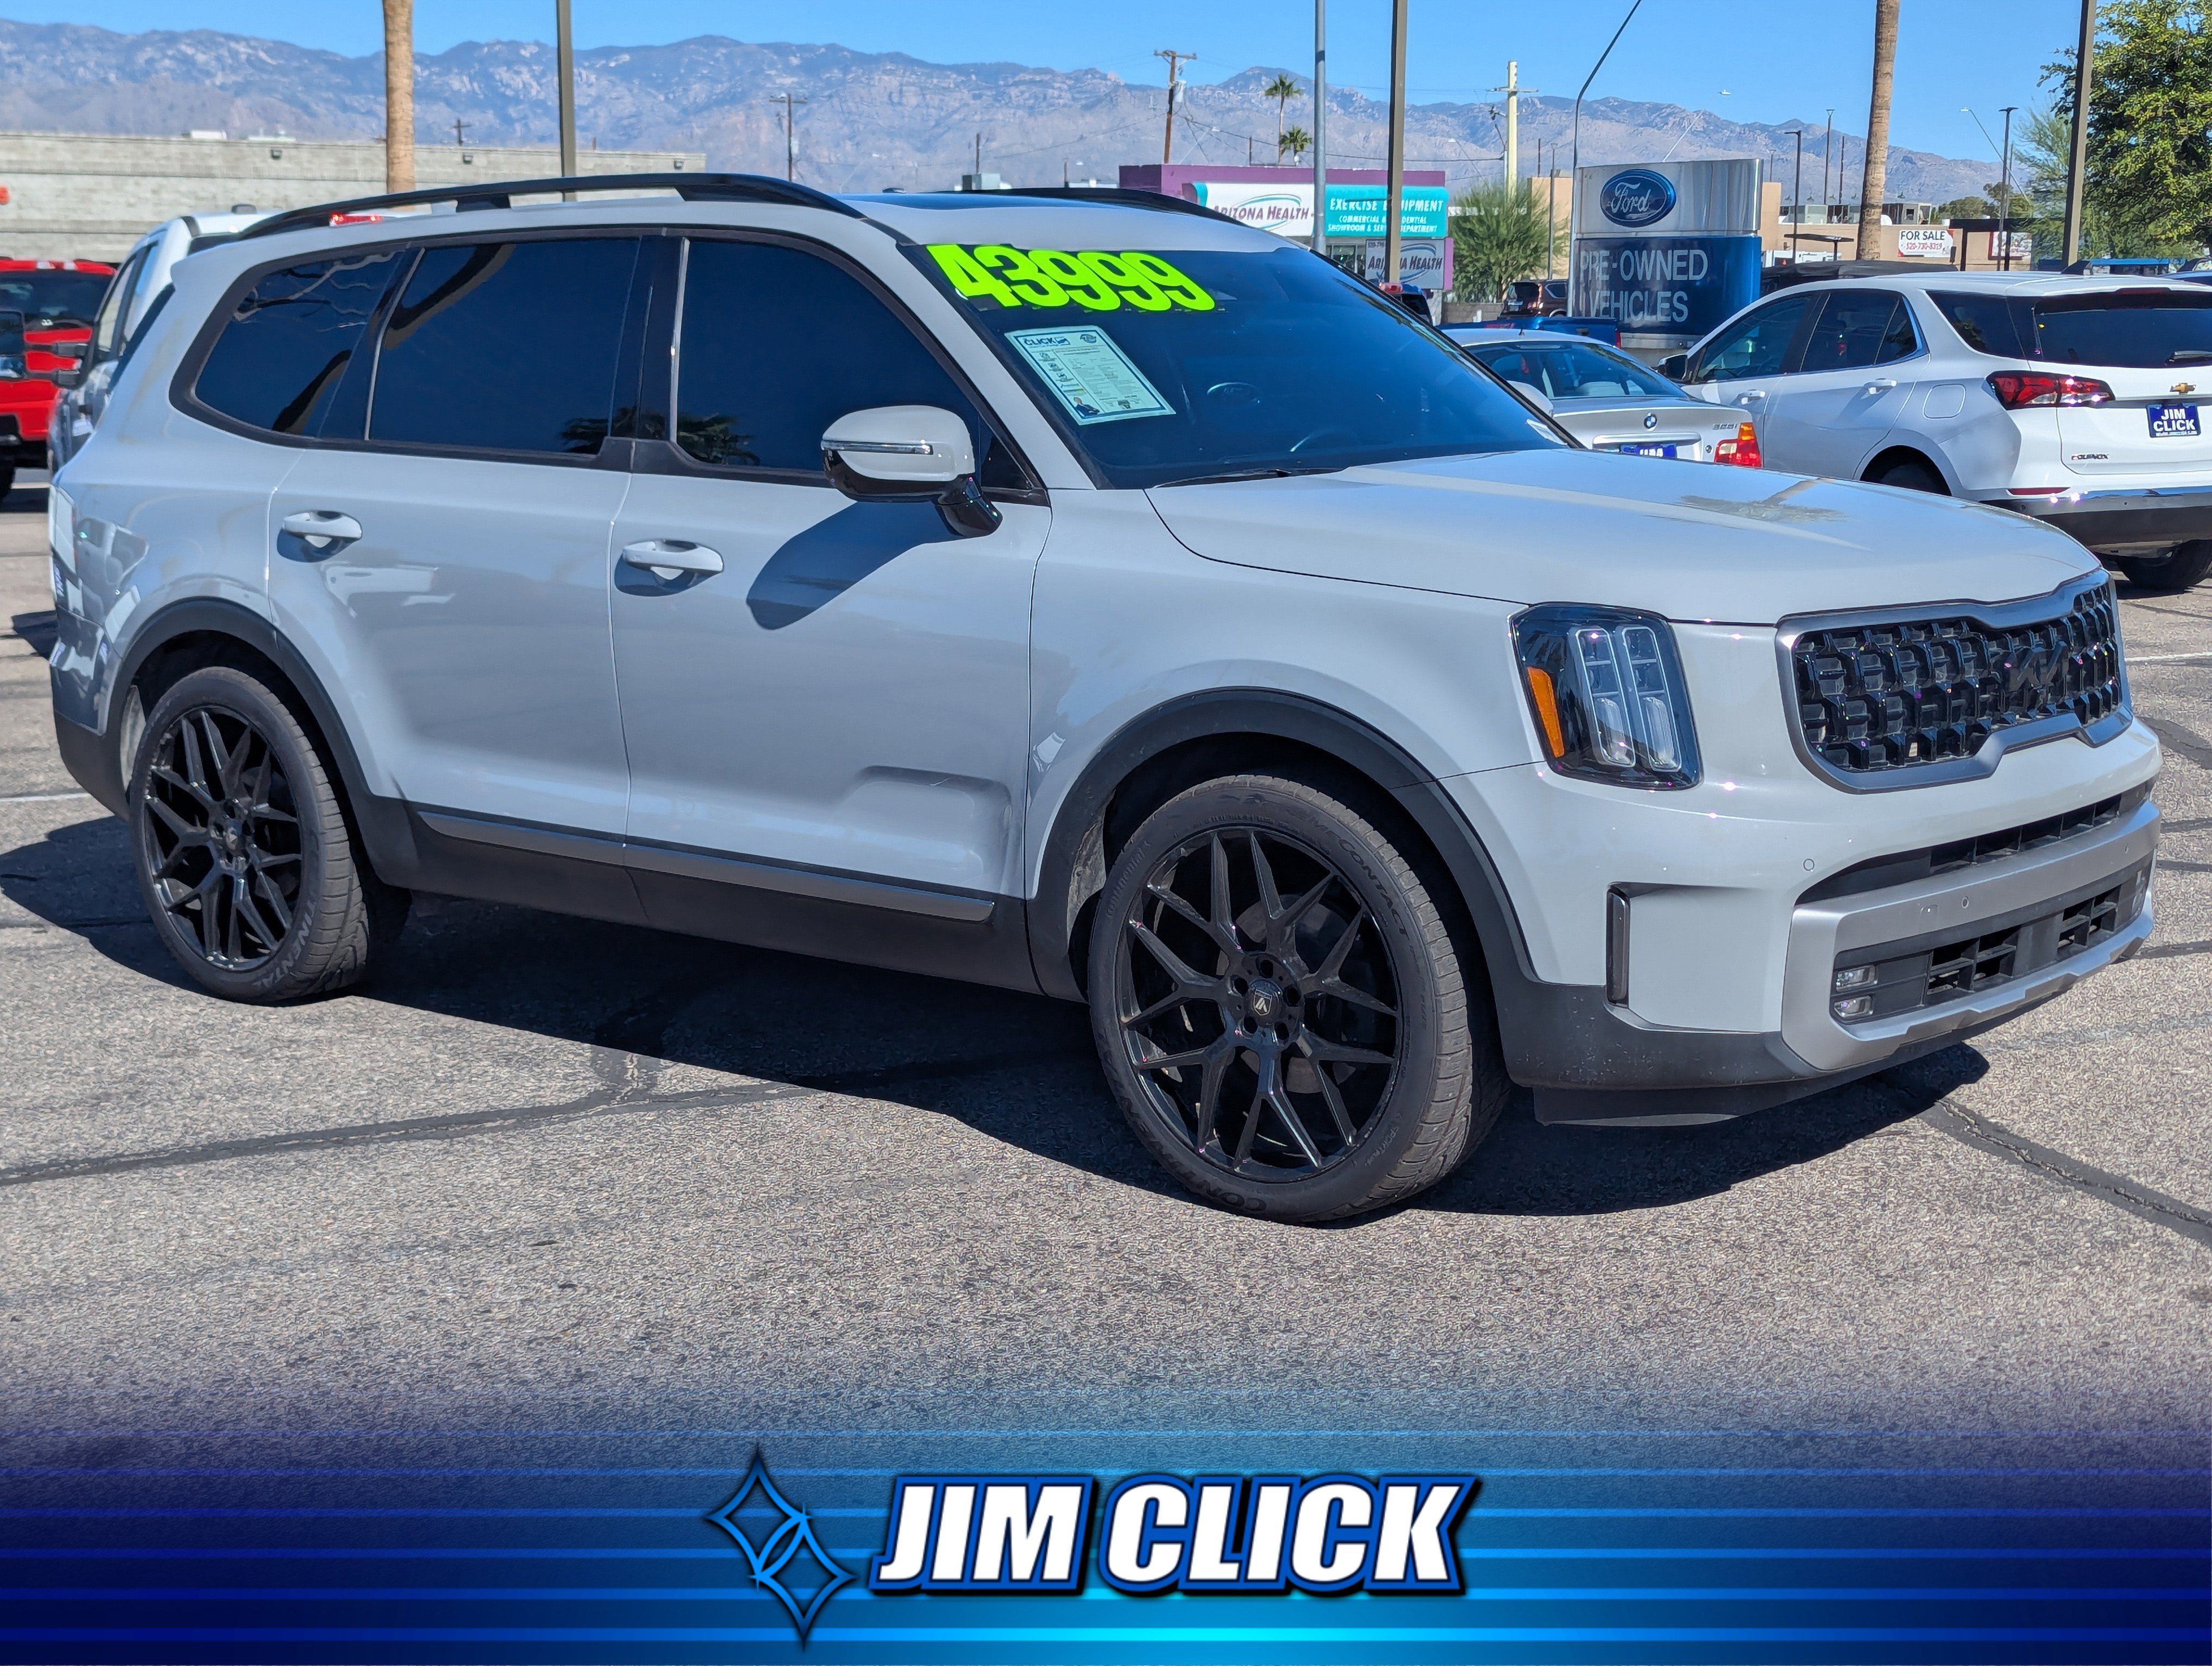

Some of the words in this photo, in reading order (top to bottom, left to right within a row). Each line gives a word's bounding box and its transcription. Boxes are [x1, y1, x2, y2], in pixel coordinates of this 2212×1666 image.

[1330, 197, 1377, 211] EXERCISE
[1383, 200, 1443, 212] EIPMENT
[1608, 182, 1651, 214] Ford
[1267, 206, 1309, 220] HEALTH
[1901, 231, 1920, 240] FOR
[1922, 231, 1945, 240] SALE
[1410, 255, 1443, 270] HEALTH
[1580, 249, 1708, 281] PRE-OWNED
[926, 244, 1216, 311] 43999
[1589, 290, 1688, 323] VEHICLES
[2161, 408, 2186, 420] JIM
[2153, 419, 2196, 432] CLICK
